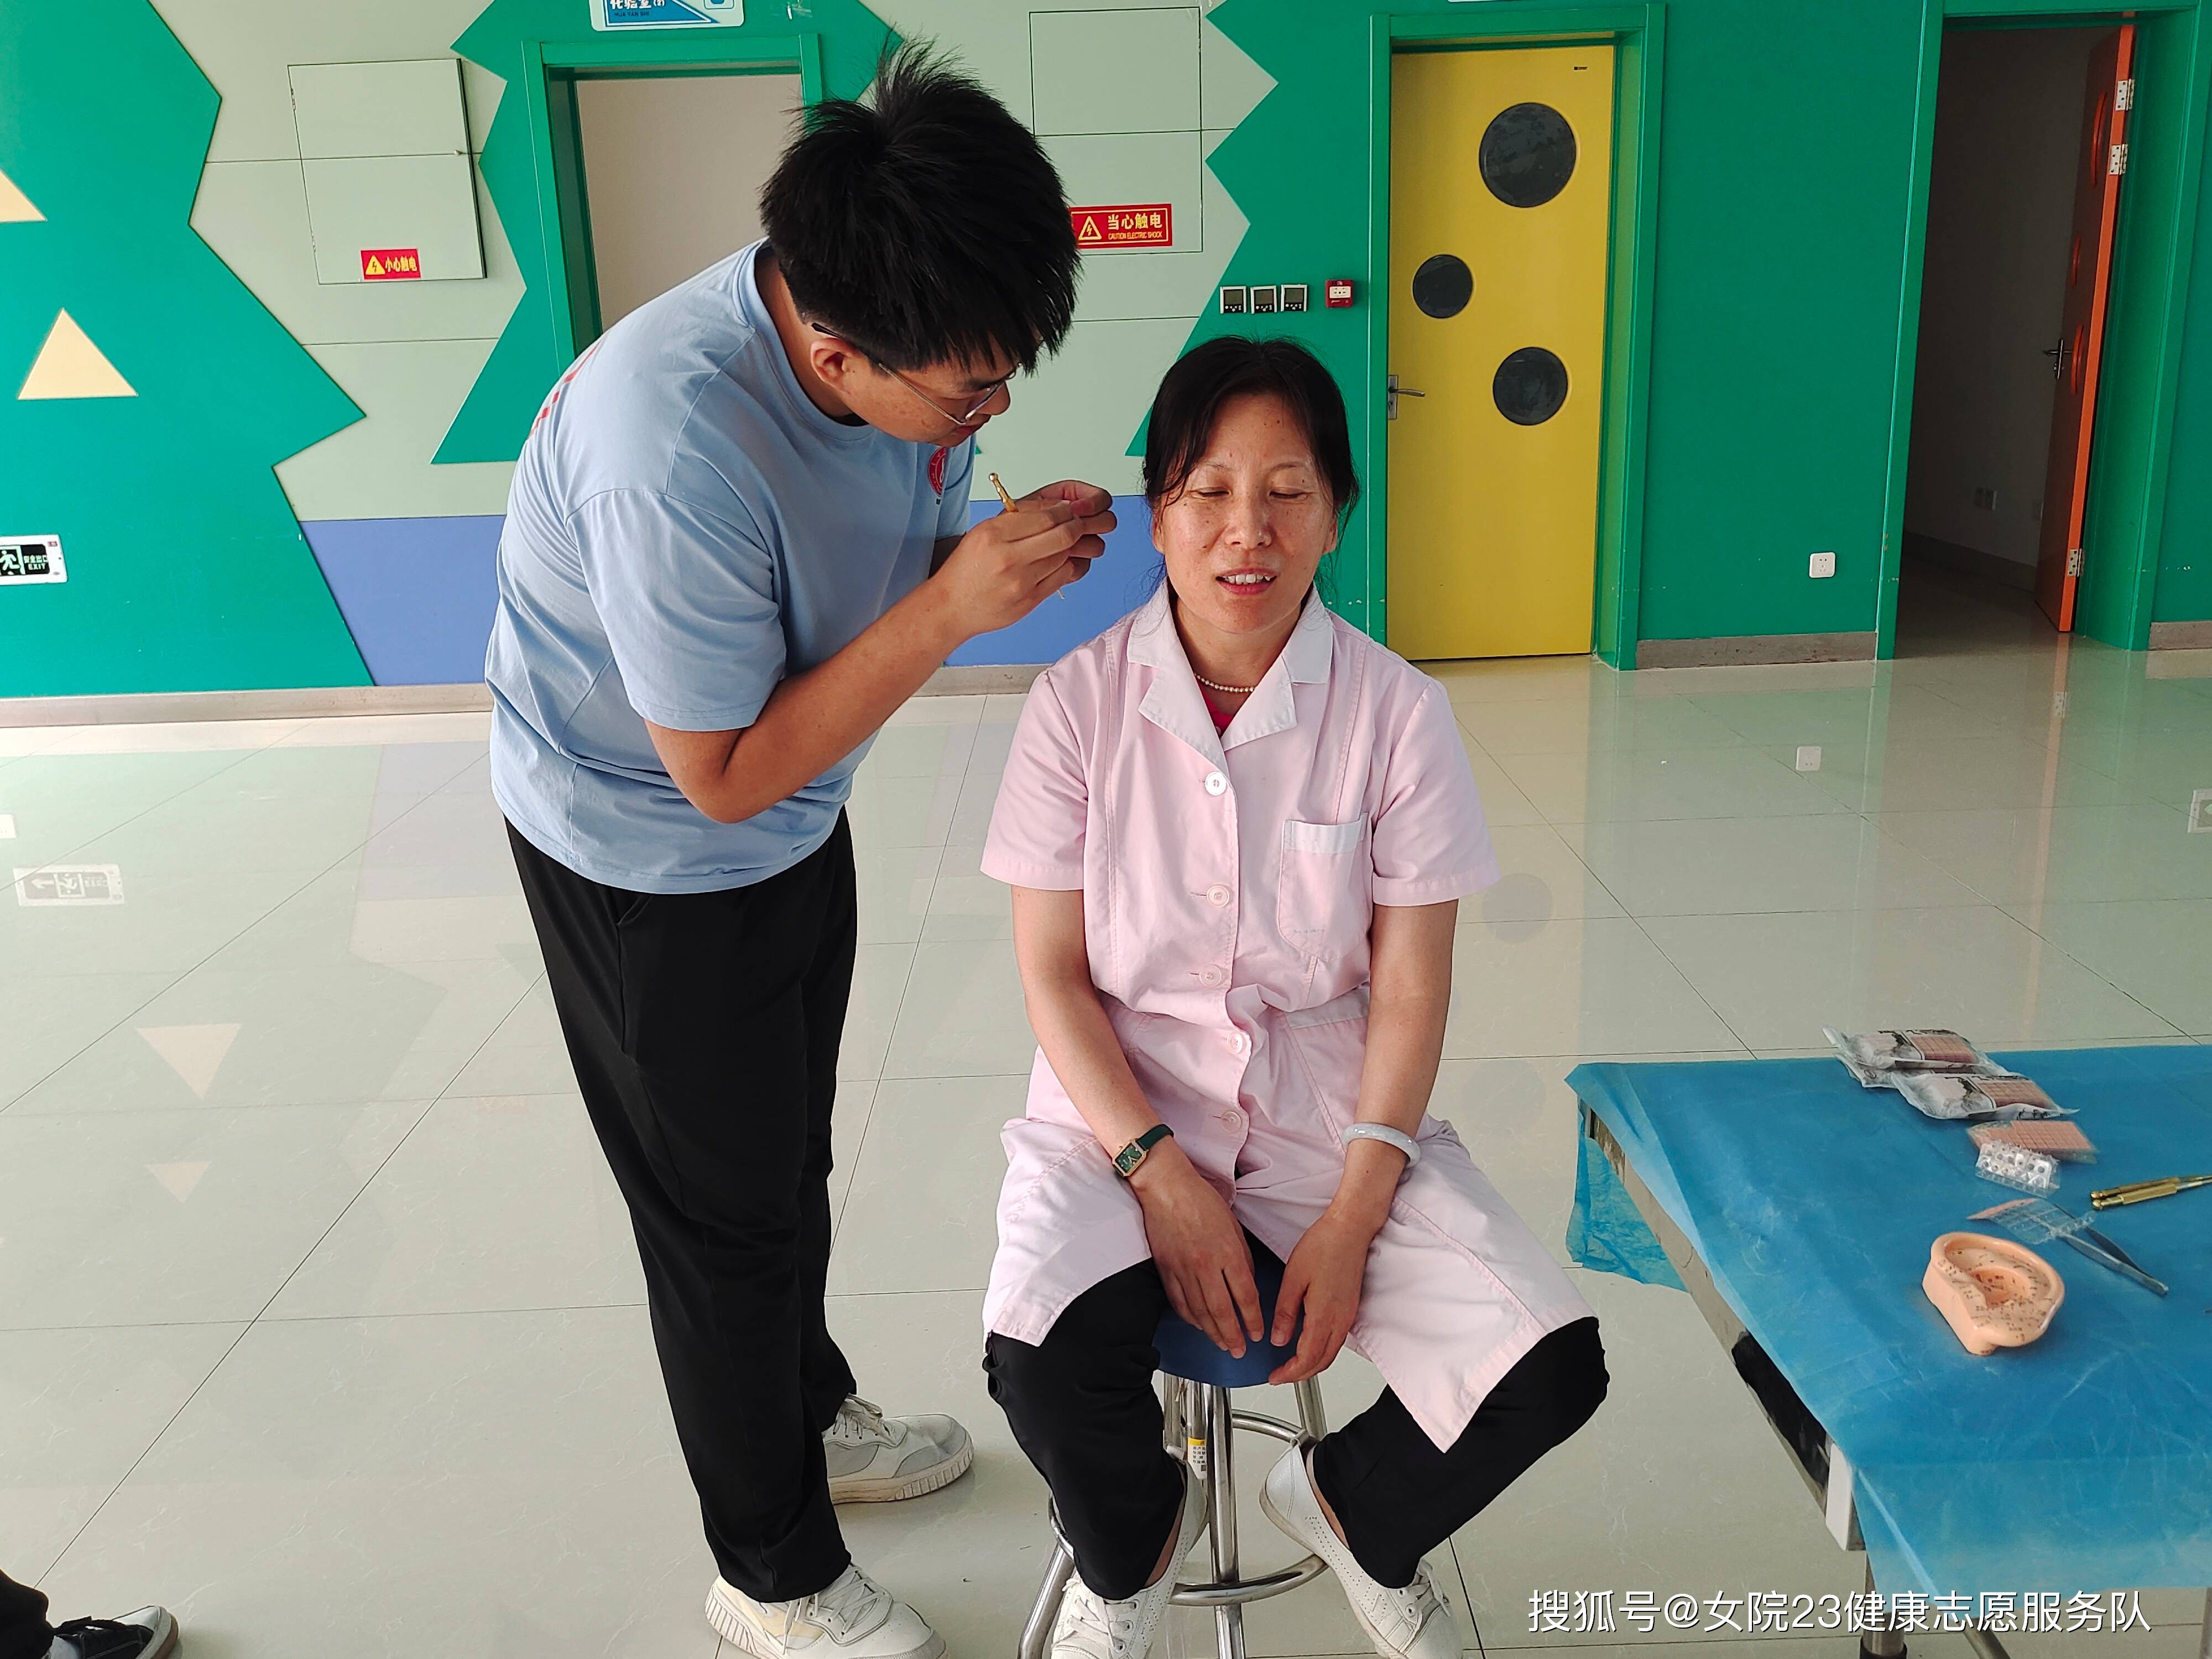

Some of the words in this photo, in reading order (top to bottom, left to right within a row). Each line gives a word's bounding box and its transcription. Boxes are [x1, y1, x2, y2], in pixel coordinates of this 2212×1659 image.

[1108, 212, 1162, 230] 当心触电
[385, 255, 418, 273] 小心触电
